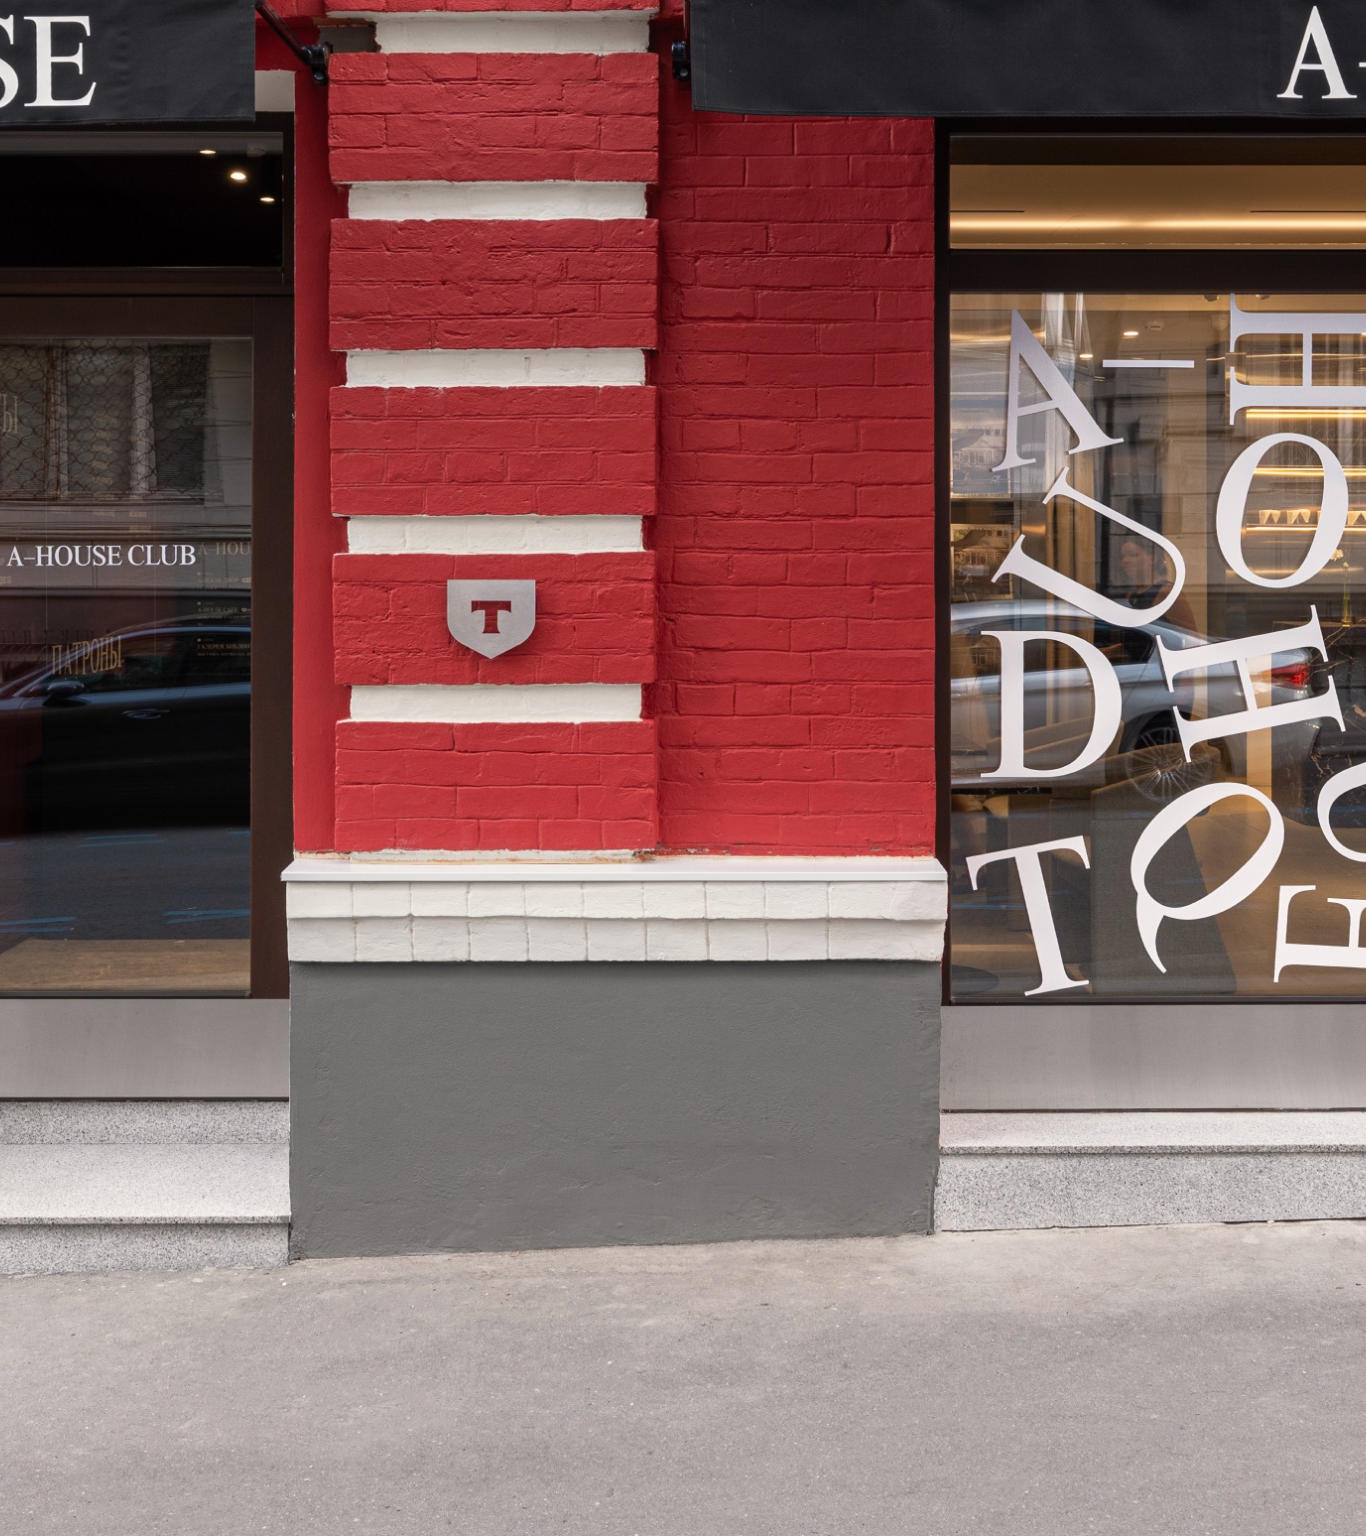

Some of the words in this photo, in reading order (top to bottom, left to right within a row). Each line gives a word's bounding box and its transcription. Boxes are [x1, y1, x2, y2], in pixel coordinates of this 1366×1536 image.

[6, 545, 123, 568] A–HOUSE
[127, 545, 196, 568] CLUB
[471, 600, 512, 634] T
[51, 635, 123, 675] ПАТРОНЫ
